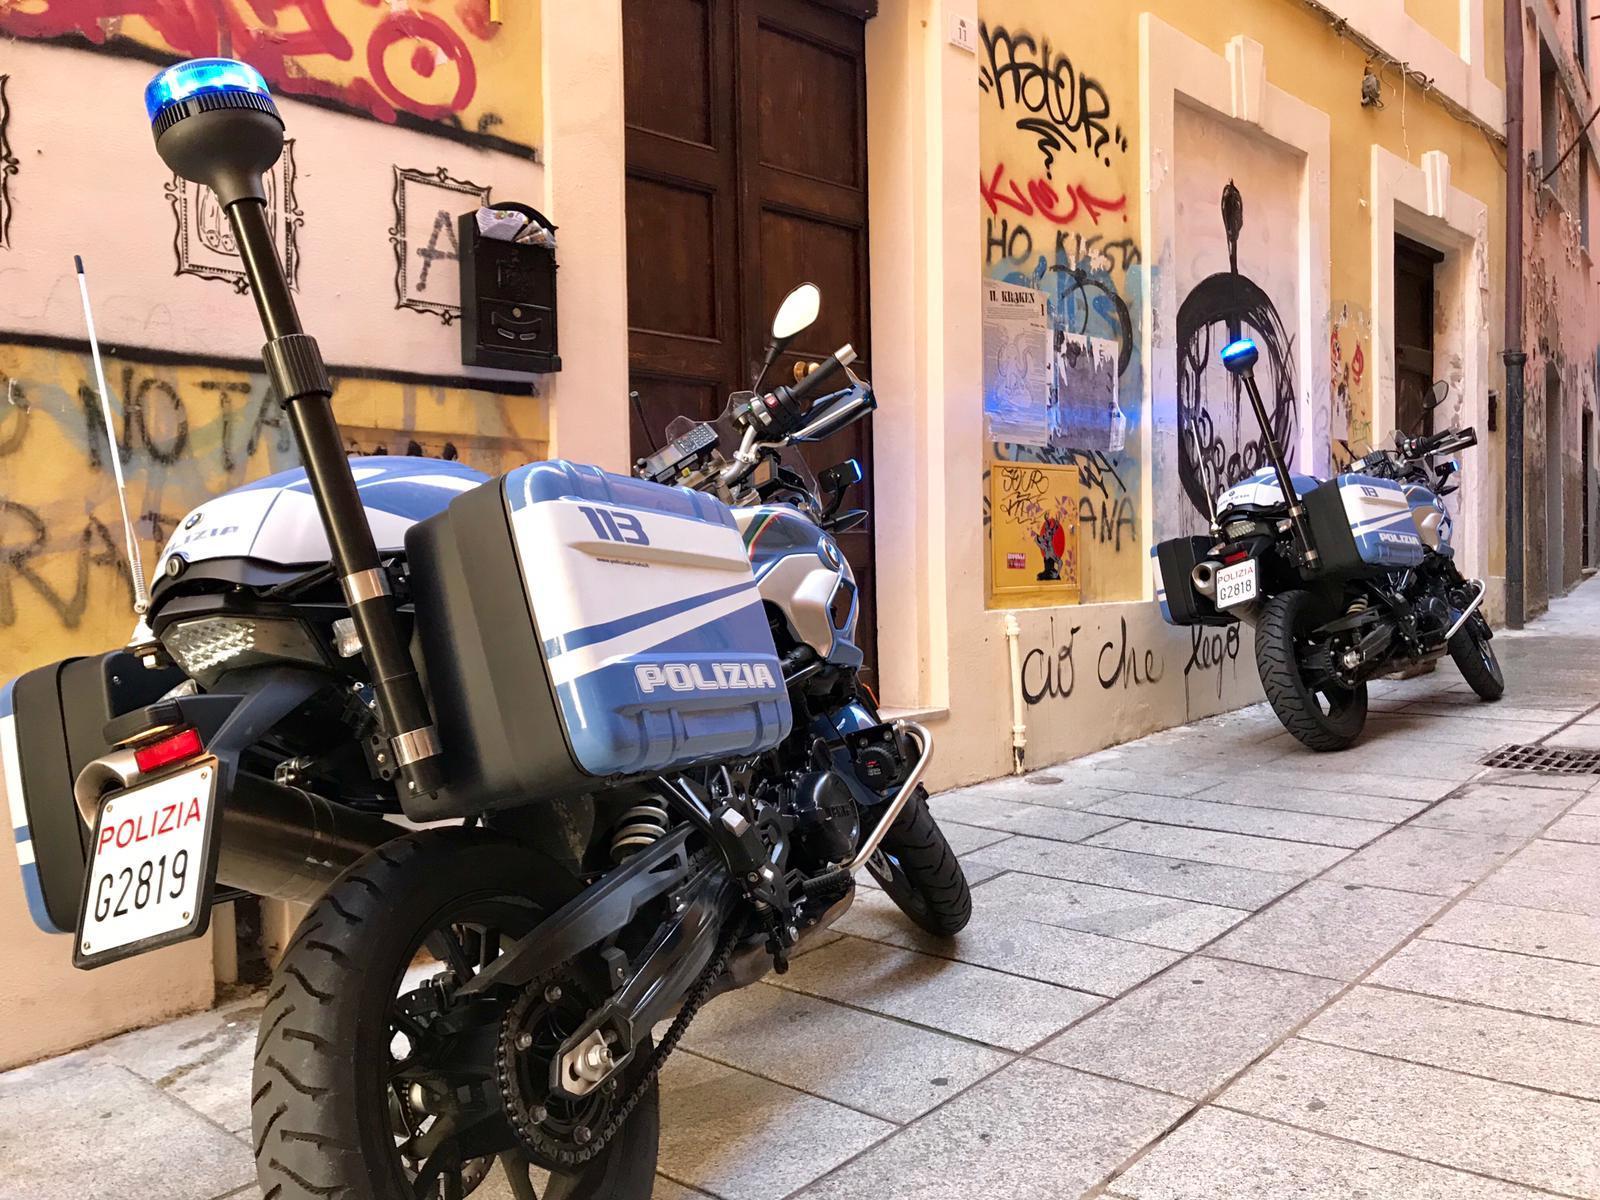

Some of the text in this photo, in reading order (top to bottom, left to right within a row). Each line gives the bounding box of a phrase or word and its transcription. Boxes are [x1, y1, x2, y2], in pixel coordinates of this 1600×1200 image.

[957, 27, 967, 42] 11
[985, 218, 1033, 265] HO
[1001, 291, 1035, 304] KRAKEN
[1361, 486, 1379, 497] 113
[578, 505, 650, 546] 113
[1379, 532, 1419, 545] POLIZIA
[1217, 566, 1254, 585] POLIZIA
[1220, 579, 1252, 601] G2818
[1098, 615, 1165, 689] che
[634, 662, 777, 693] POLIZIA
[97, 797, 201, 856] POLIZIA
[94, 848, 189, 923] G2819
